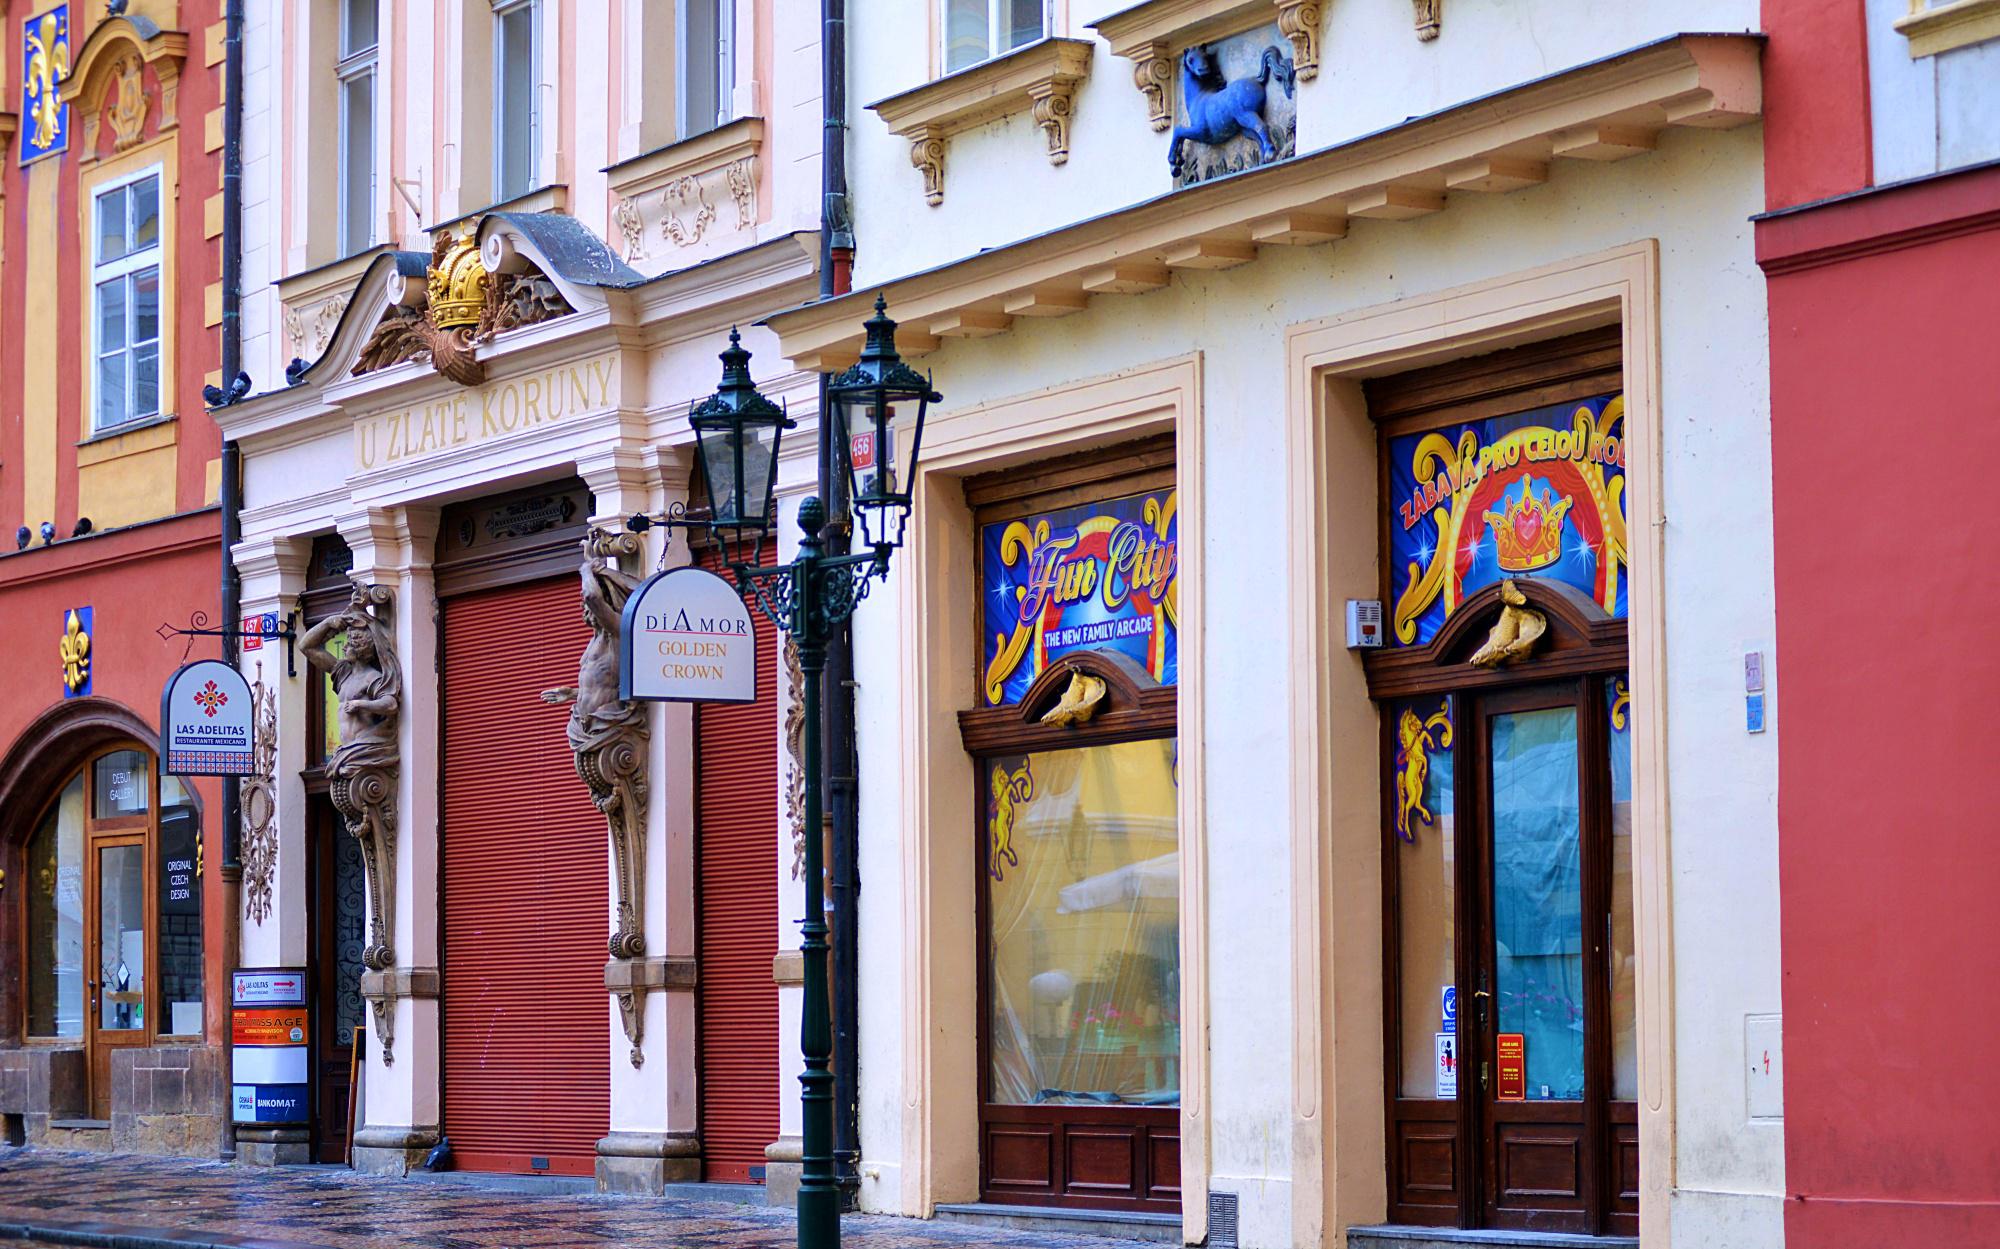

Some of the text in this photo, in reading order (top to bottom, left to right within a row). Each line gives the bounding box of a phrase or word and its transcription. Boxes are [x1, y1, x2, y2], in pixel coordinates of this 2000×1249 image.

[360, 421, 377, 469] U
[481, 356, 616, 438] KORUNY
[853, 437, 869, 457] 456
[1479, 439, 1520, 477] PRO
[1525, 430, 1585, 462] CELOU
[1019, 522, 1177, 621] Fun City
[1045, 616, 1153, 647] THE NEW FAMILY ARCADE
[658, 639, 727, 658] GOLDEN
[662, 663, 723, 681] CROWN
[176, 724, 245, 736] LAS ADELITAS
[112, 771, 132, 785] DEBUT
[167, 860, 193, 872] ORIGINAL
[170, 875, 189, 886] CZECH
[170, 889, 190, 900] DESIGN
[257, 1099, 296, 1108] BANKOMAT
